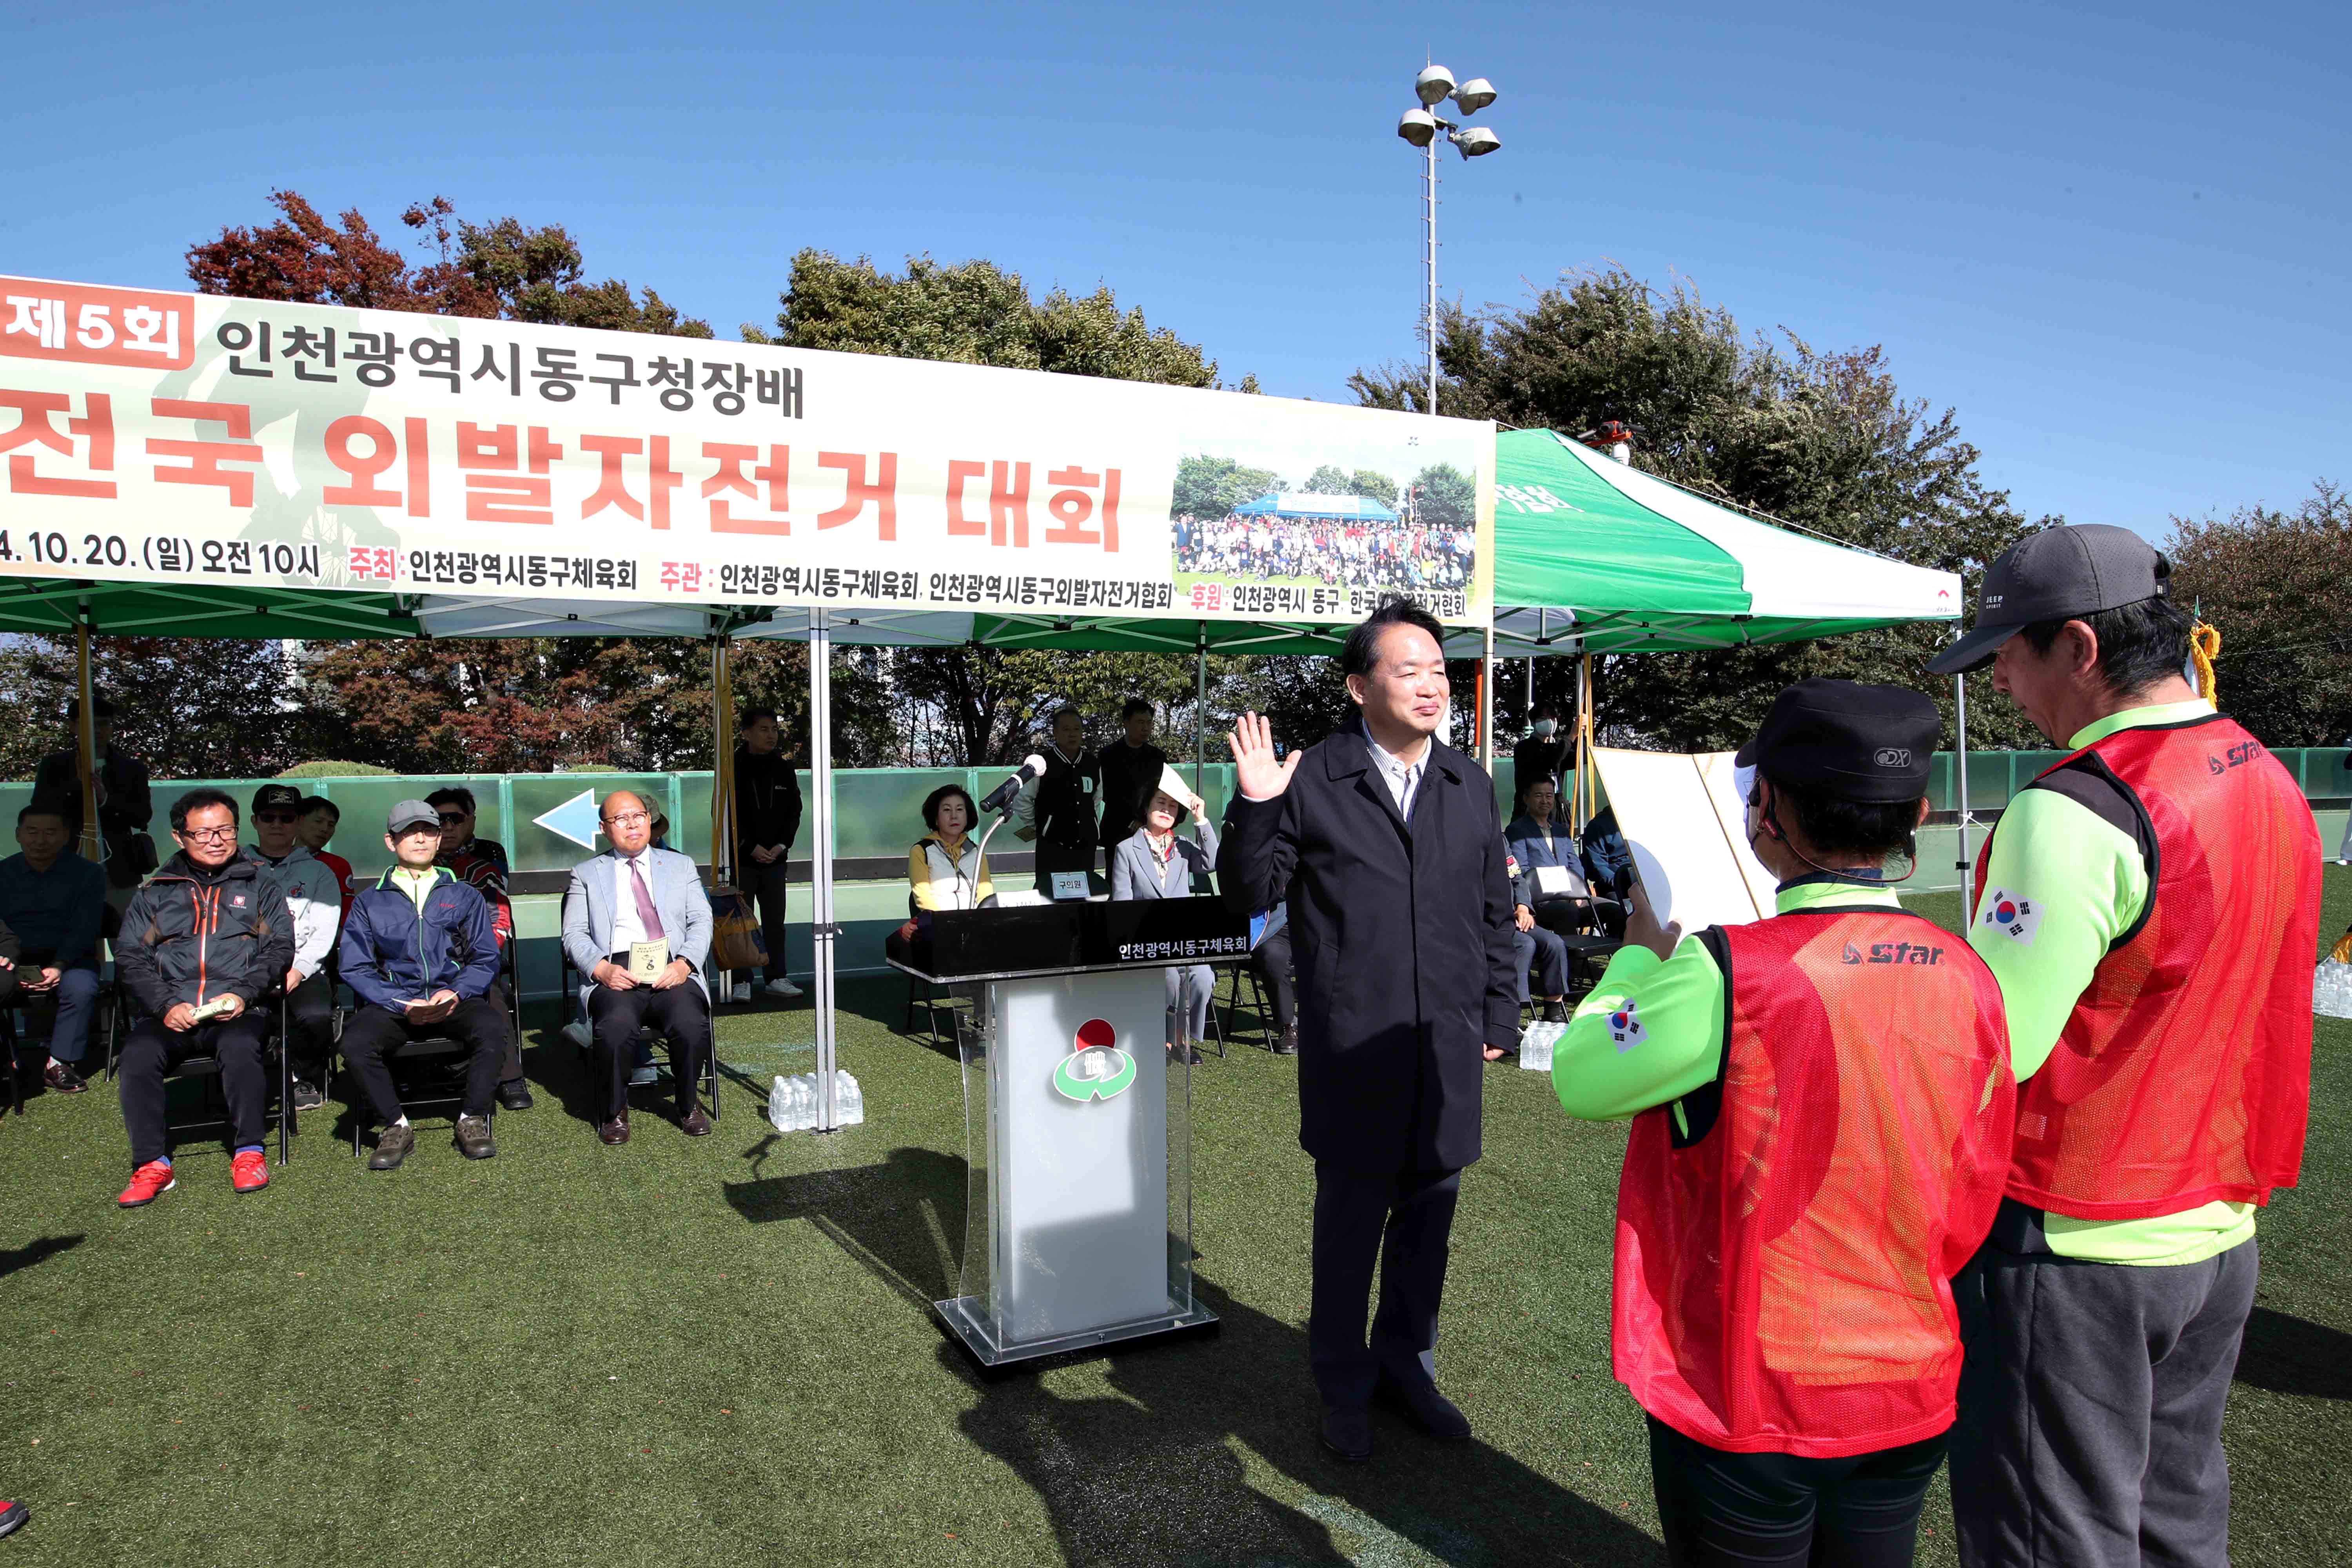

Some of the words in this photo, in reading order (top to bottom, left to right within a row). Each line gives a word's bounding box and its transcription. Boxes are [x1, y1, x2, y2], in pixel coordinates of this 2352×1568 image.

[6, 295, 179, 360] 제5회
[217, 321, 803, 419] 인천광역시동구청장배
[0, 388, 263, 508] 전국
[323, 415, 897, 541] 외발자전거
[946, 460, 1121, 552] 대회
[1060, 880, 1081, 889] 구의원
[1119, 936, 1246, 960] 인천광역시동구체육회
